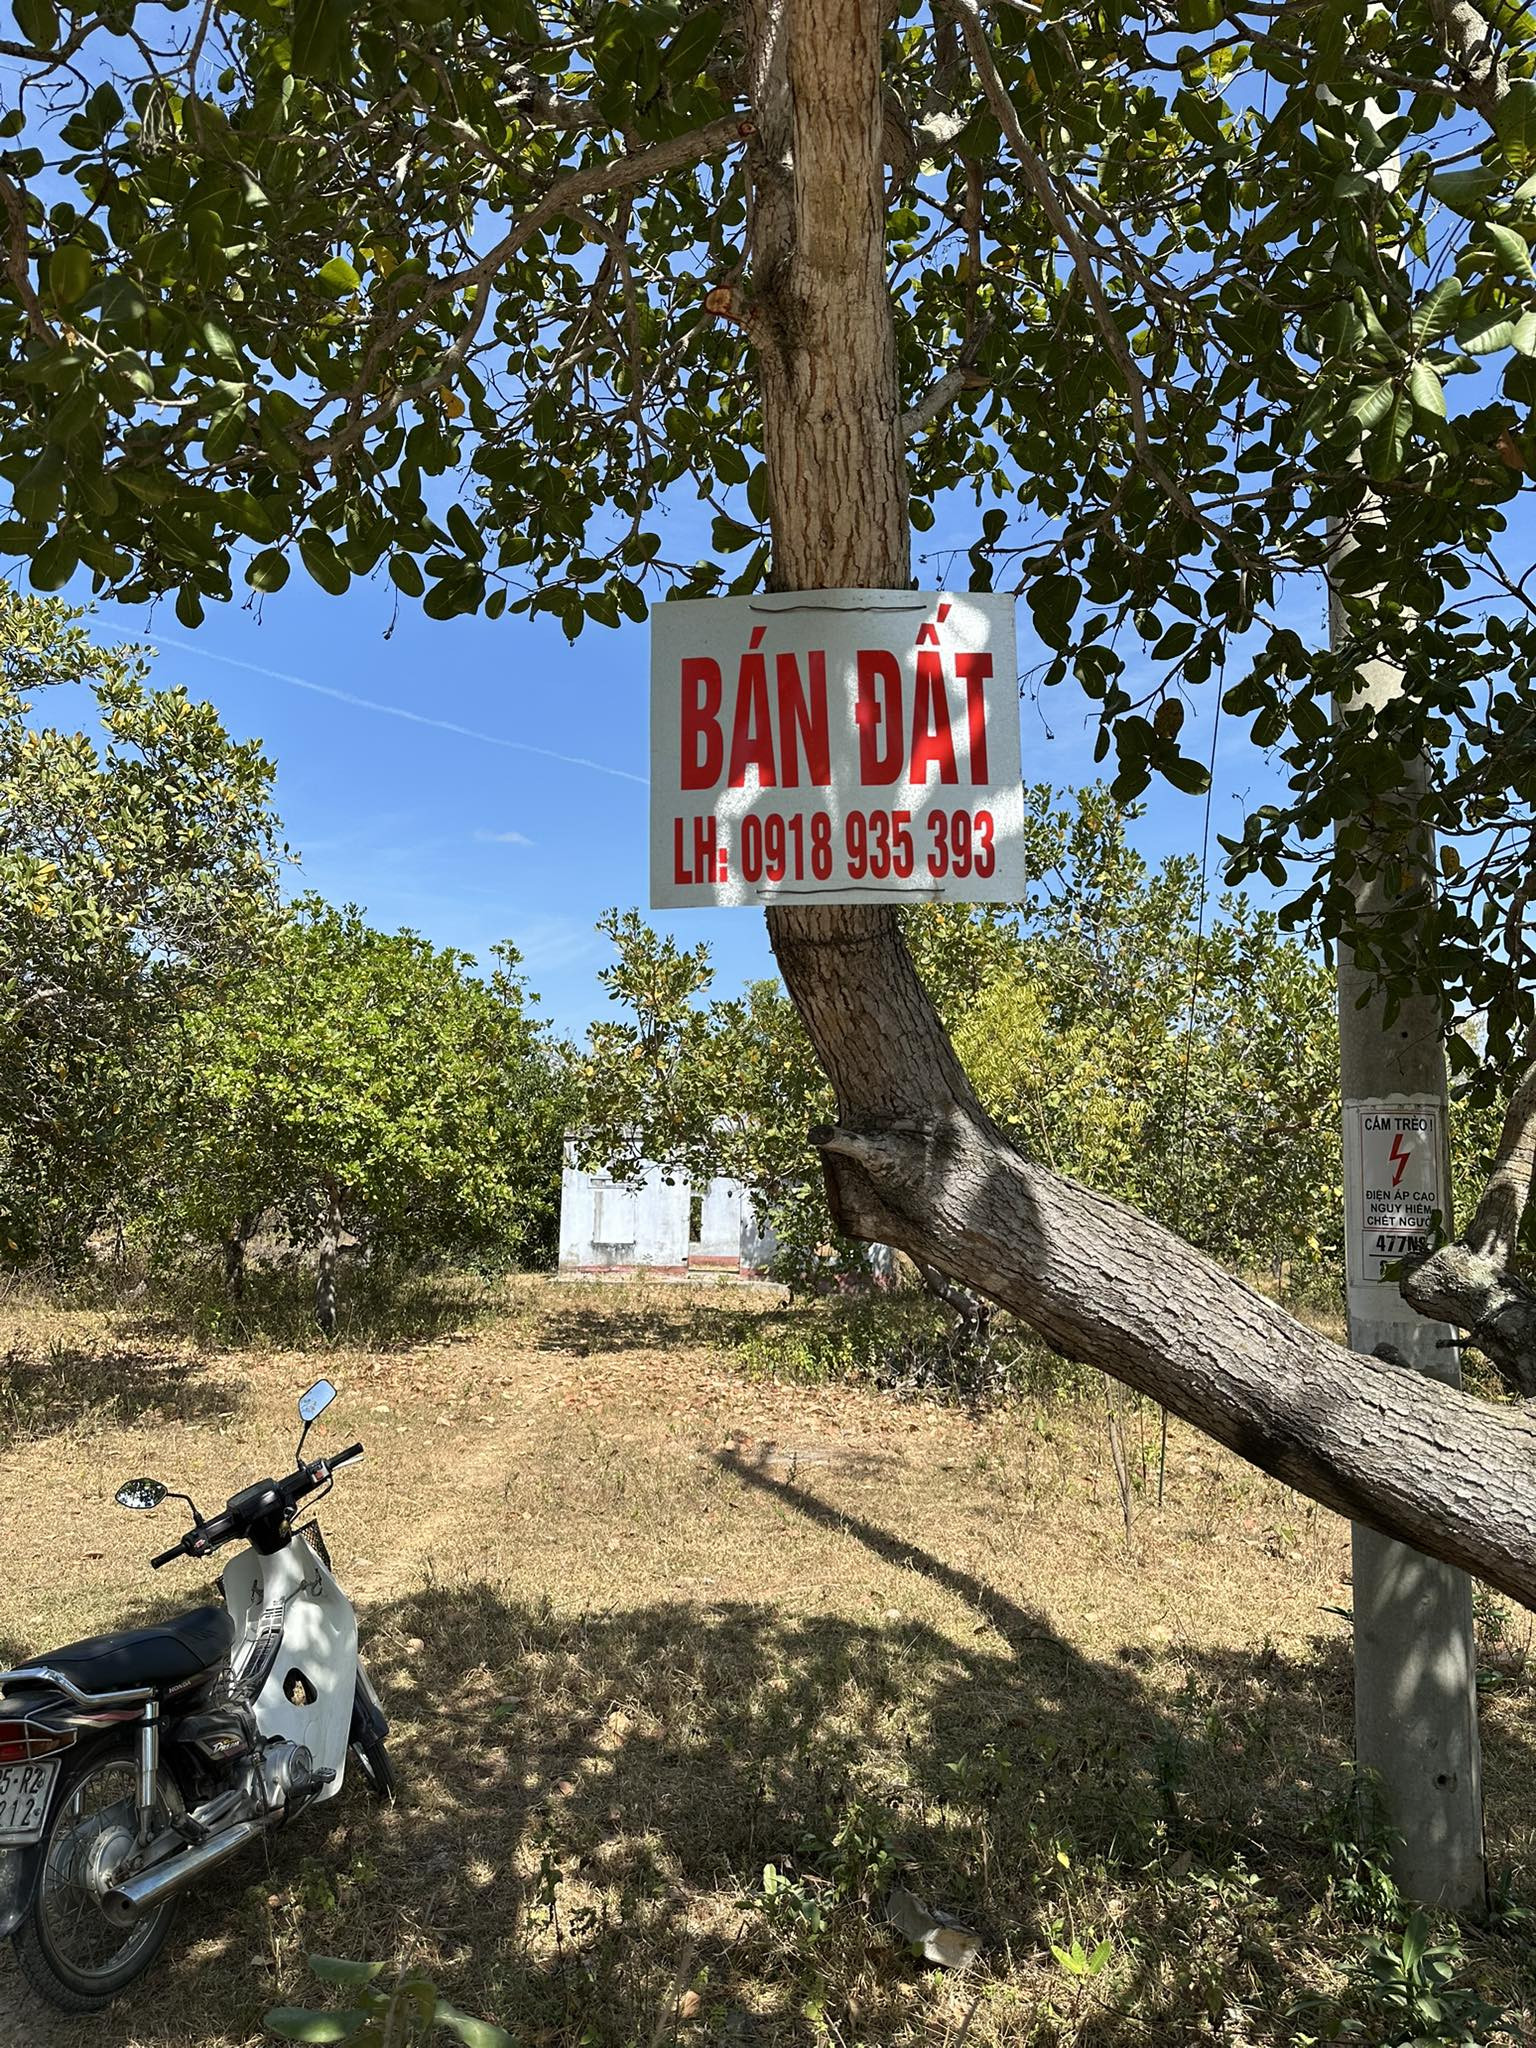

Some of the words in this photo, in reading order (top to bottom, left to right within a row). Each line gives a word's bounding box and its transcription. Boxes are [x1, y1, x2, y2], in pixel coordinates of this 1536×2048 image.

[681, 626, 831, 790] BÁN
[855, 603, 993, 786] ĐẤT
[674, 816, 728, 884] LH:
[741, 811, 832, 883] 0918
[845, 810, 914, 880] 935
[927, 809, 996, 879] 393
[1366, 1190, 1391, 1202] ĐIỆN
[1394, 1189, 1410, 1201] ÁP
[1413, 1191, 1436, 1202] CAO
[1370, 1203, 1402, 1213] NGUY
[1367, 1215, 1396, 1226] CHẾT
[168, 1680, 192, 1694] HONDA
